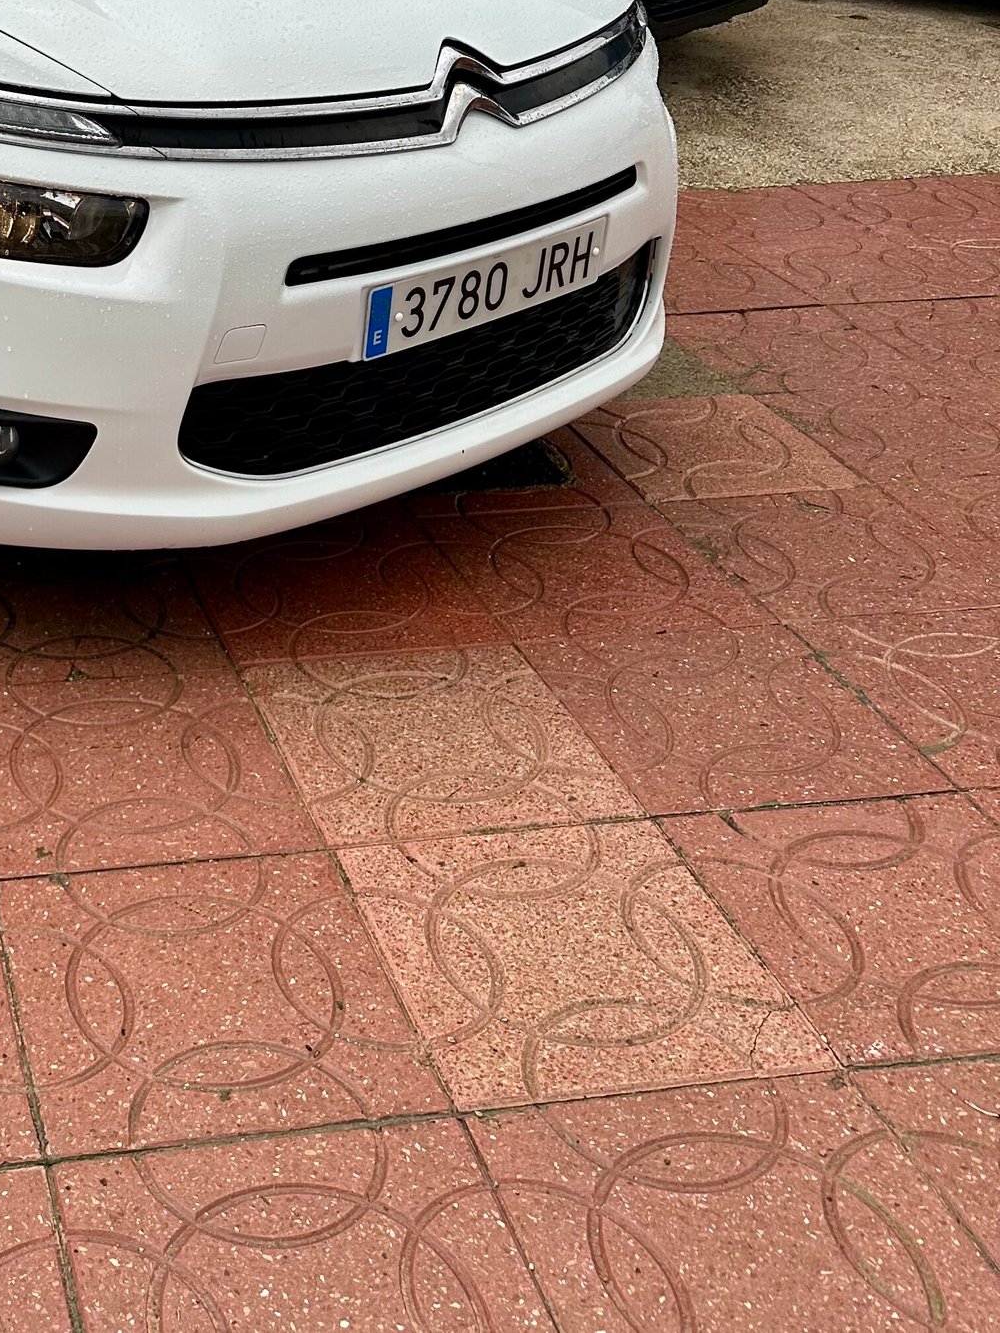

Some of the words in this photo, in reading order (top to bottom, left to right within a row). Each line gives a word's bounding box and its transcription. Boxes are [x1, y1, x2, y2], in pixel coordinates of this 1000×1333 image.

[373, 329, 383, 346] E
[401, 261, 508, 338] 3780
[522, 231, 594, 300] JRH
